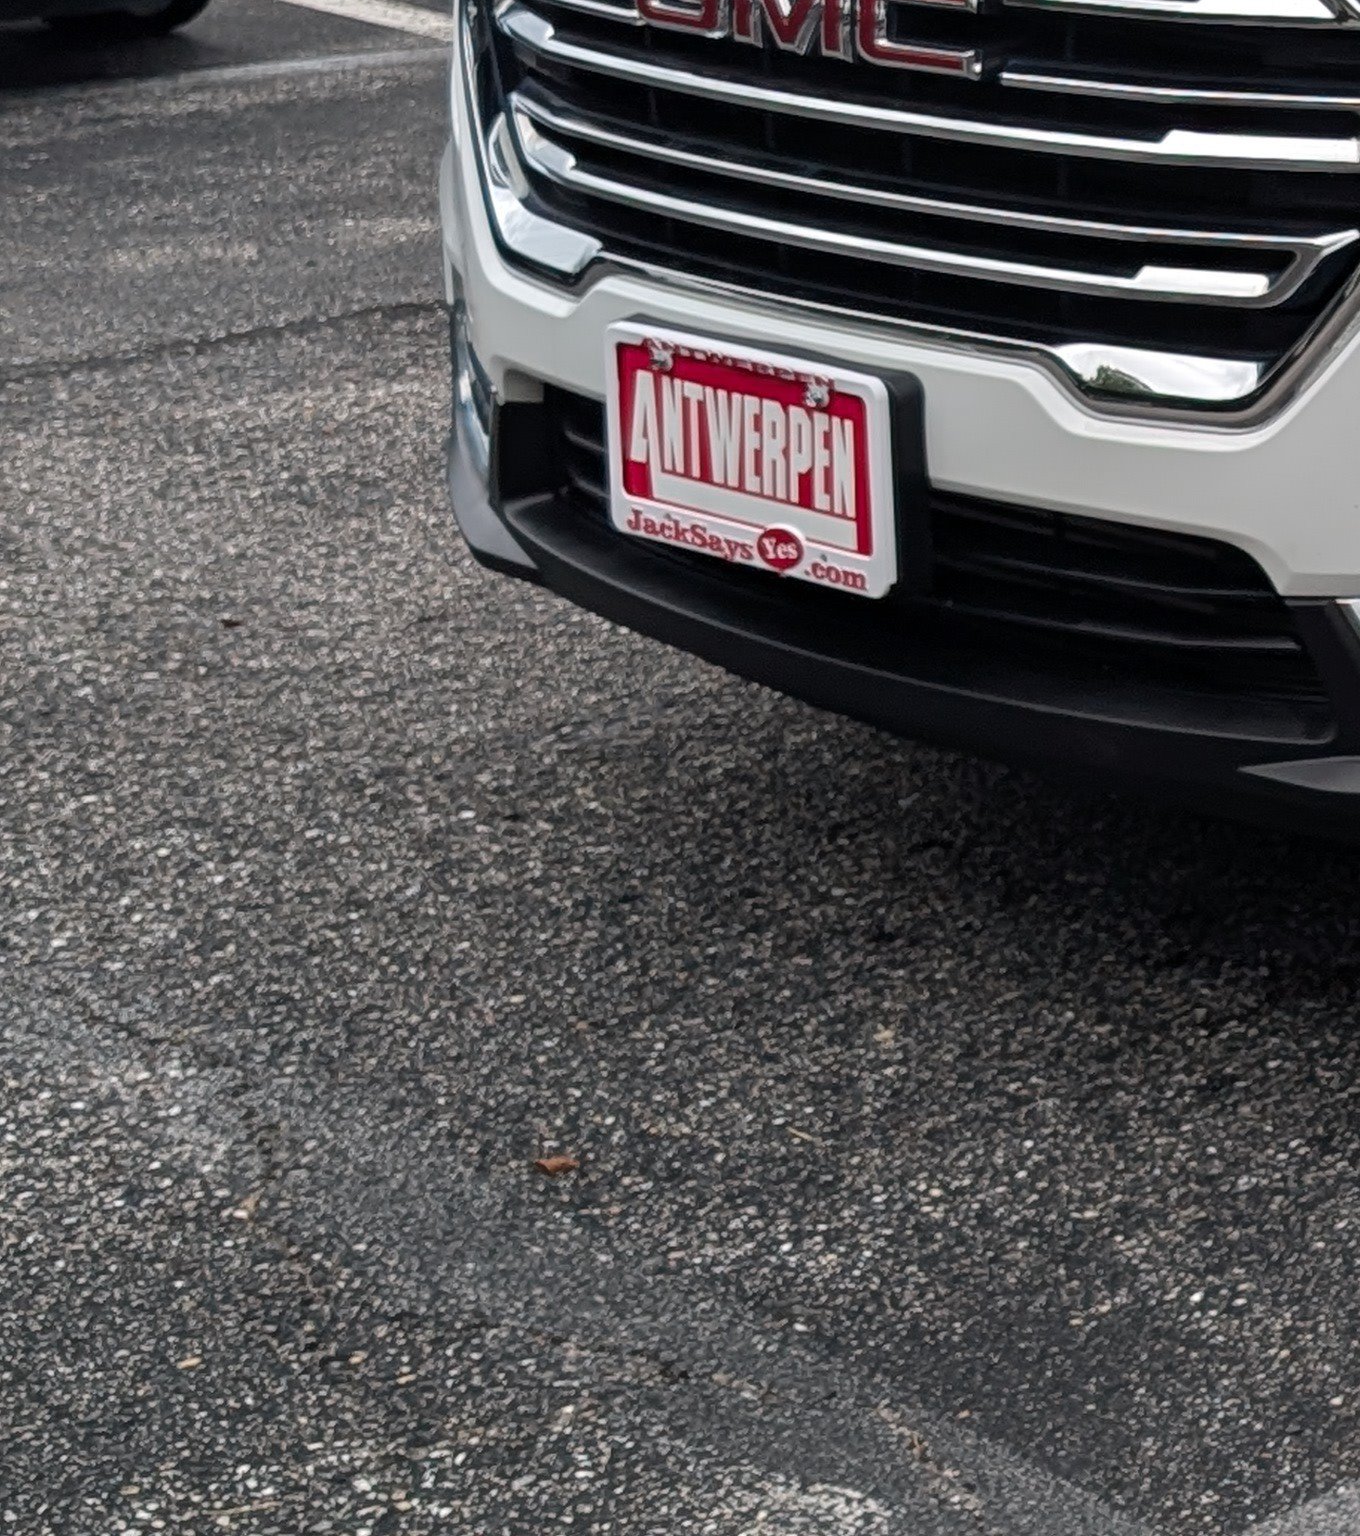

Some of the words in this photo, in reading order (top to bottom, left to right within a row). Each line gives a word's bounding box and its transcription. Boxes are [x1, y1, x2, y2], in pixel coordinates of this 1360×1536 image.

[630, 369, 857, 521] ANTWERPEN
[626, 508, 754, 561] JackSays
[761, 537, 799, 561] Yes
